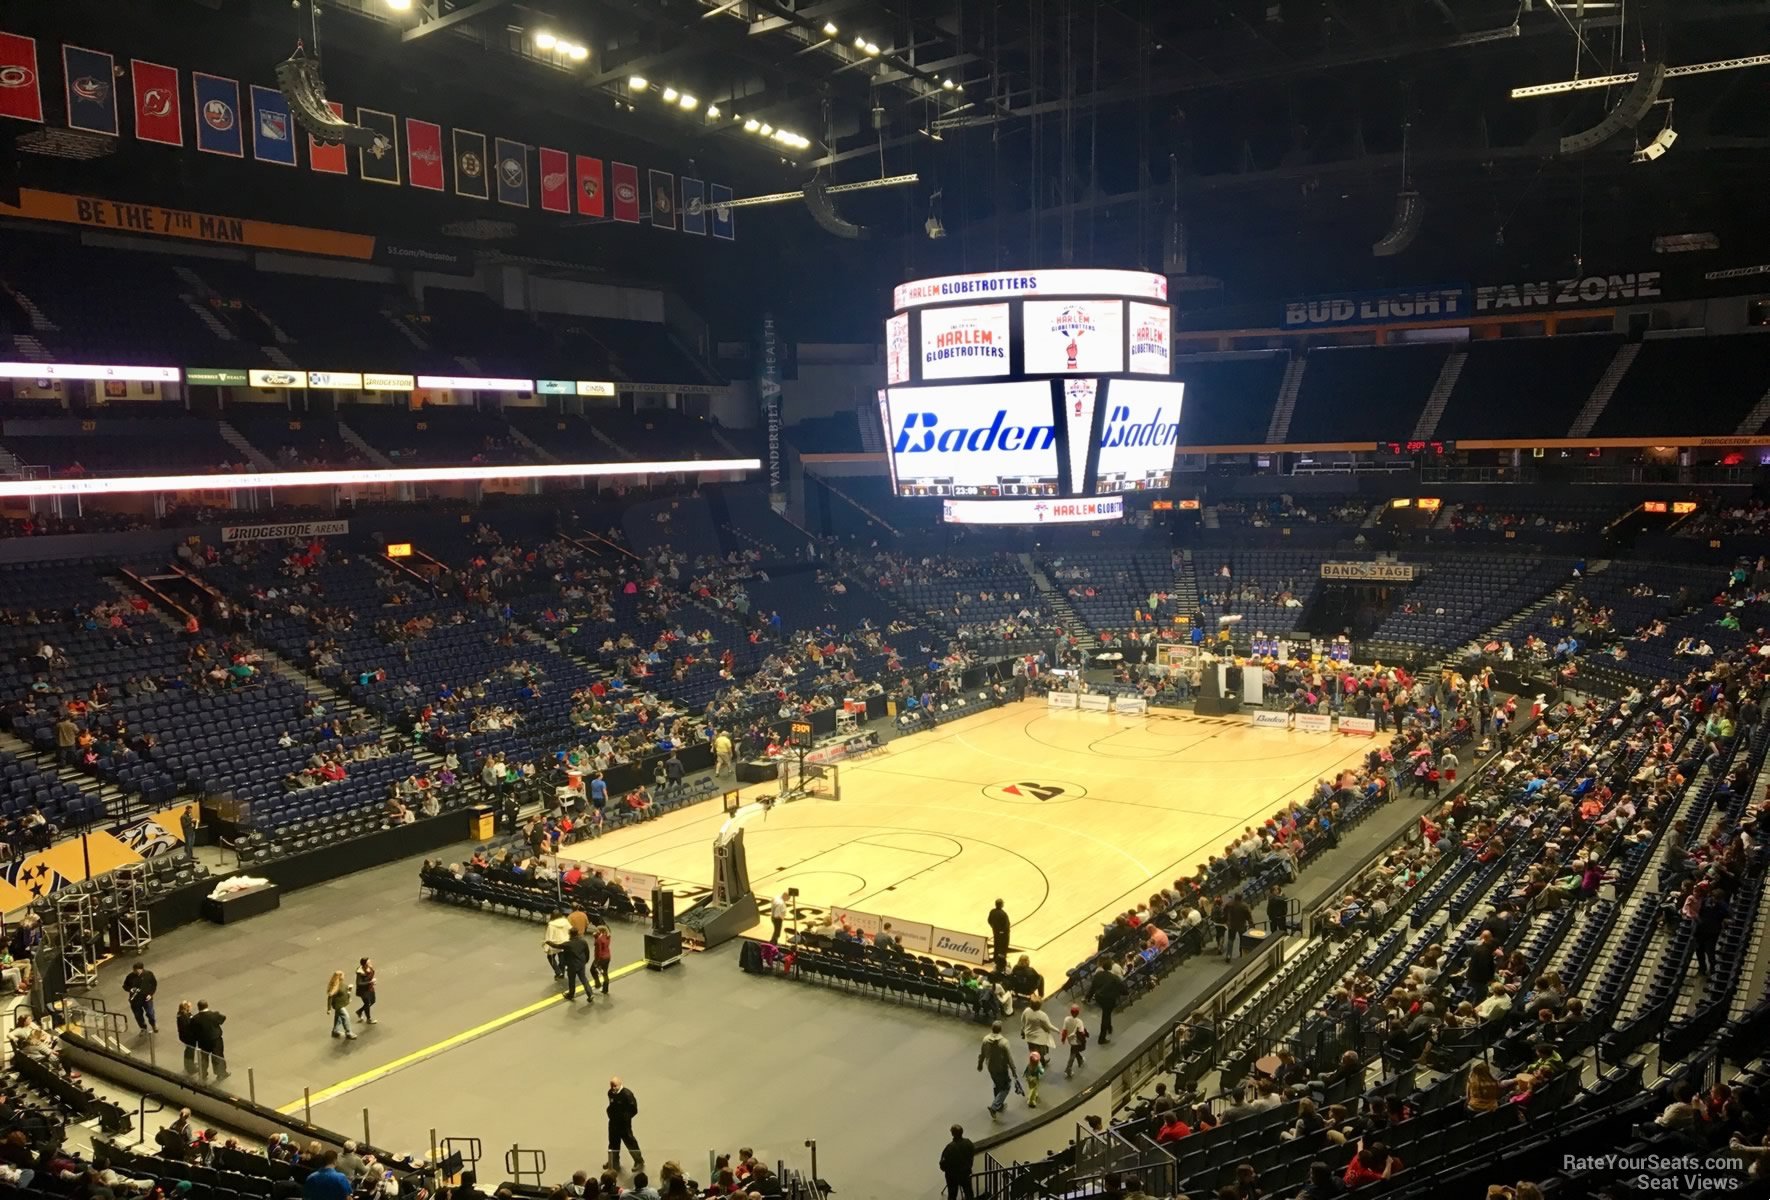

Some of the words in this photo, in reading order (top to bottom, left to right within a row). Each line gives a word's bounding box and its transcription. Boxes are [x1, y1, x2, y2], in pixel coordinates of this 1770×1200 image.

[77, 198, 106, 224] BE
[112, 203, 155, 230] THE
[160, 210, 192, 233] 7TH
[199, 215, 243, 242] MAN
[909, 284, 940, 299] HARLEM
[941, 276, 1037, 295] GLOBETROTTERS
[1286, 299, 1355, 325] BUD
[1361, 288, 1463, 319] LIGHT
[1477, 281, 1549, 310] FAN
[1555, 271, 1661, 304] ZONE
[1056, 315, 1090, 324] HARLEM
[936, 329, 993, 348] HARLEM
[1136, 327, 1163, 345] HARLEM
[765, 319, 777, 375] HEALTH
[926, 345, 1004, 363] GLOBETROTTERS
[1131, 343, 1168, 358] GLOBETROTTERS
[266, 374, 290, 385] Ford
[366, 377, 412, 387] BRIDGESTONE
[894, 410, 1056, 453] Baden
[1101, 406, 1179, 449] Baden
[767, 402, 781, 488] VANDERBILT
[1054, 503, 1096, 516] HARLEM
[227, 524, 311, 540] BRIDGESTONE
[313, 523, 344, 534] ARENA
[1324, 566, 1359, 575] BAND
[1369, 567, 1411, 576] STAGE
[791, 723, 810, 733] 2309
[1256, 714, 1286, 724] Baden
[936, 936, 980, 956] Baden
